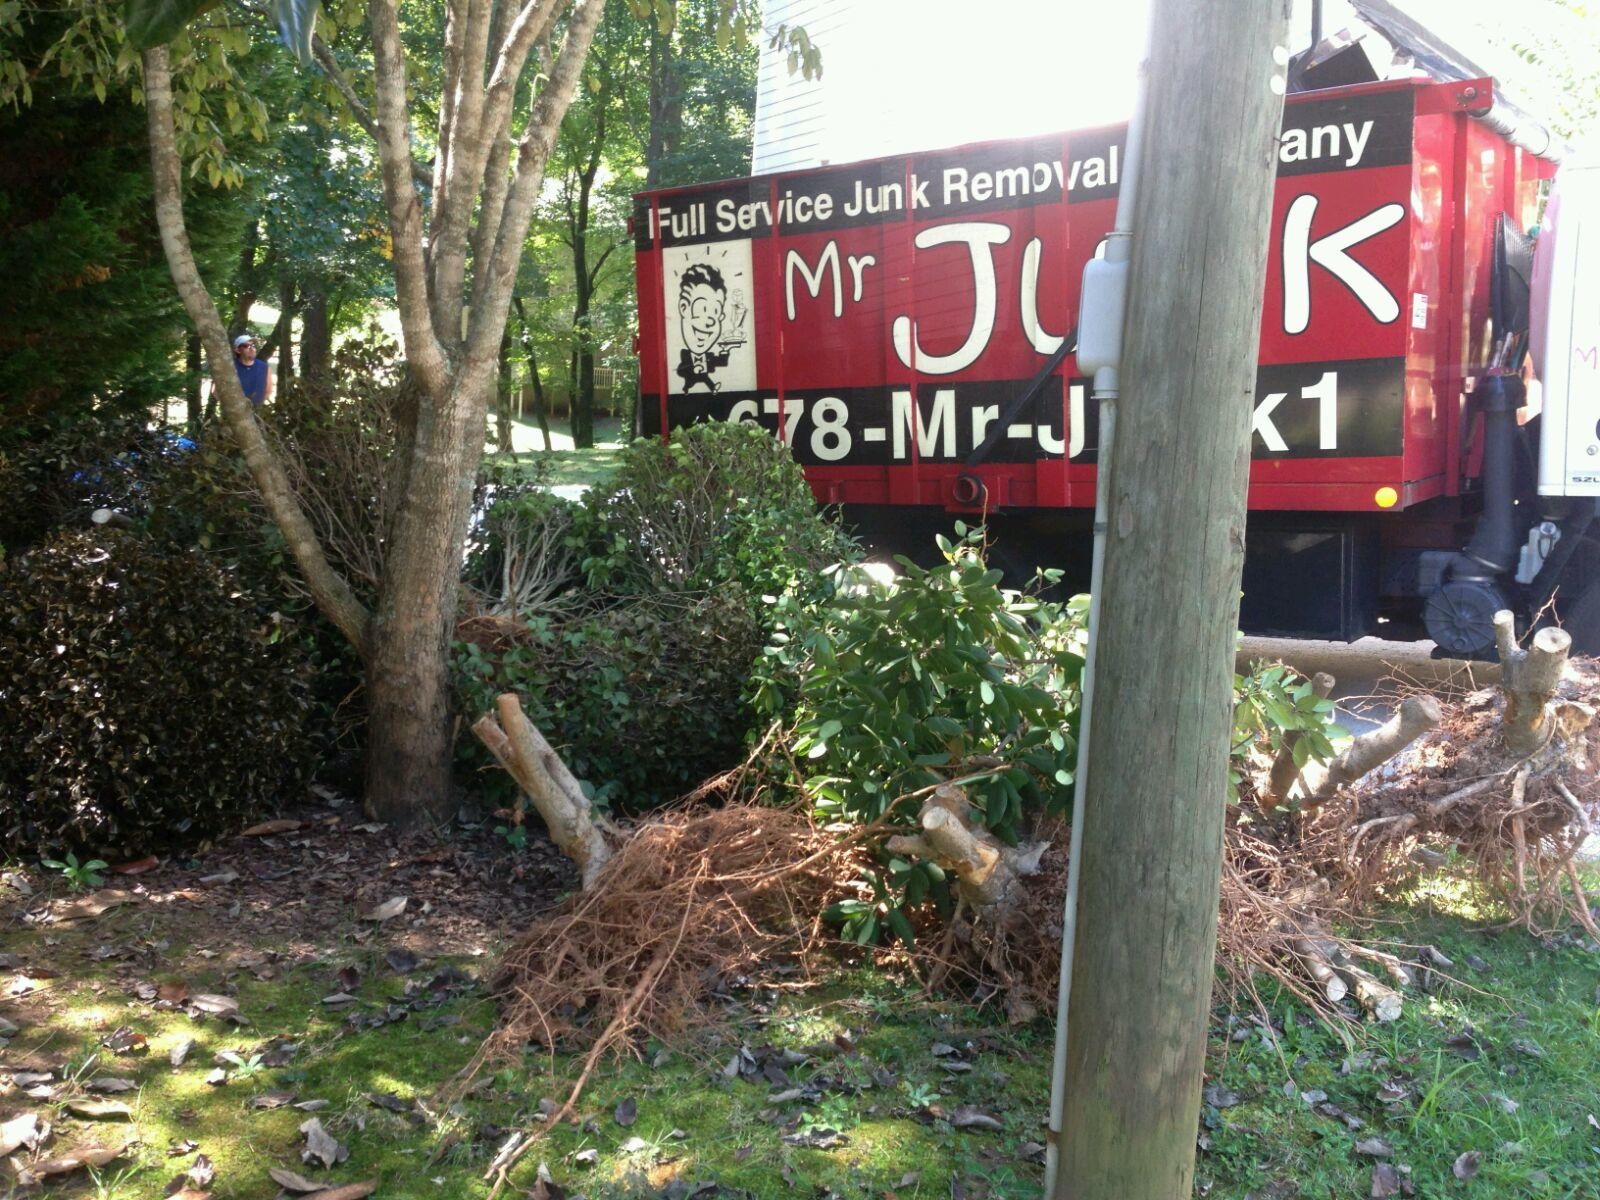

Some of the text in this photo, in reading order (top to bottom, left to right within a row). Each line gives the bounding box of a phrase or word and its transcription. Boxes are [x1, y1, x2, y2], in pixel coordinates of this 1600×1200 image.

[648, 145, 1119, 239] Full Service Junk Removal
[785, 194, 1405, 375] Mr JUK
[728, 371, 1339, 462] 78-Mr-Jk1
